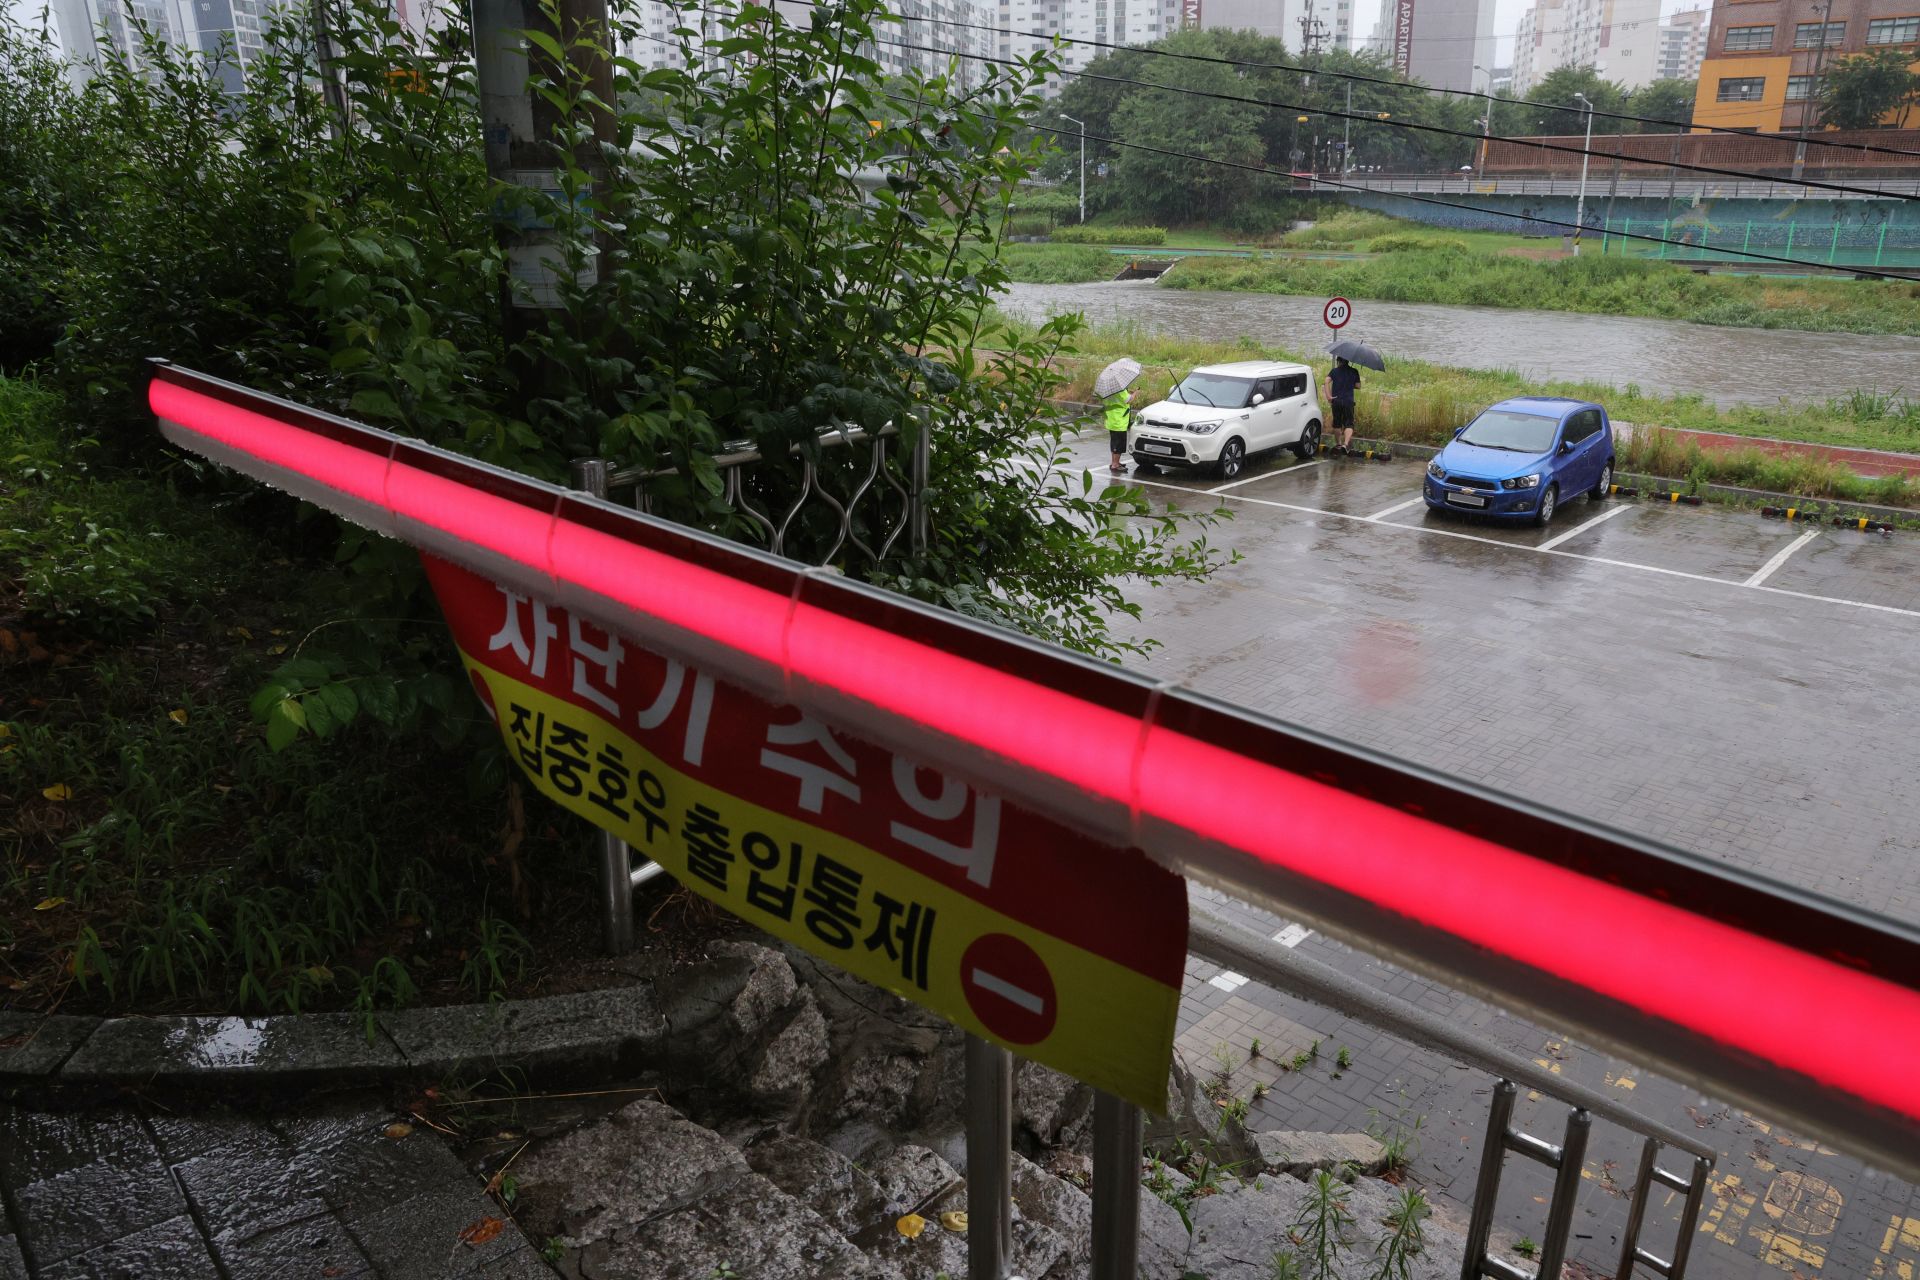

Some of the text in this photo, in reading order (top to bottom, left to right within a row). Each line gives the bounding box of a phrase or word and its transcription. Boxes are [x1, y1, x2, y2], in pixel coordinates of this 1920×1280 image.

[1397, 2, 1411, 76] APARTMENT
[1621, 48, 1632, 57] 101
[1331, 306, 1345, 319] 20
[760, 706, 1002, 889] 주의
[510, 703, 936, 990] 집중호우 출입통제
